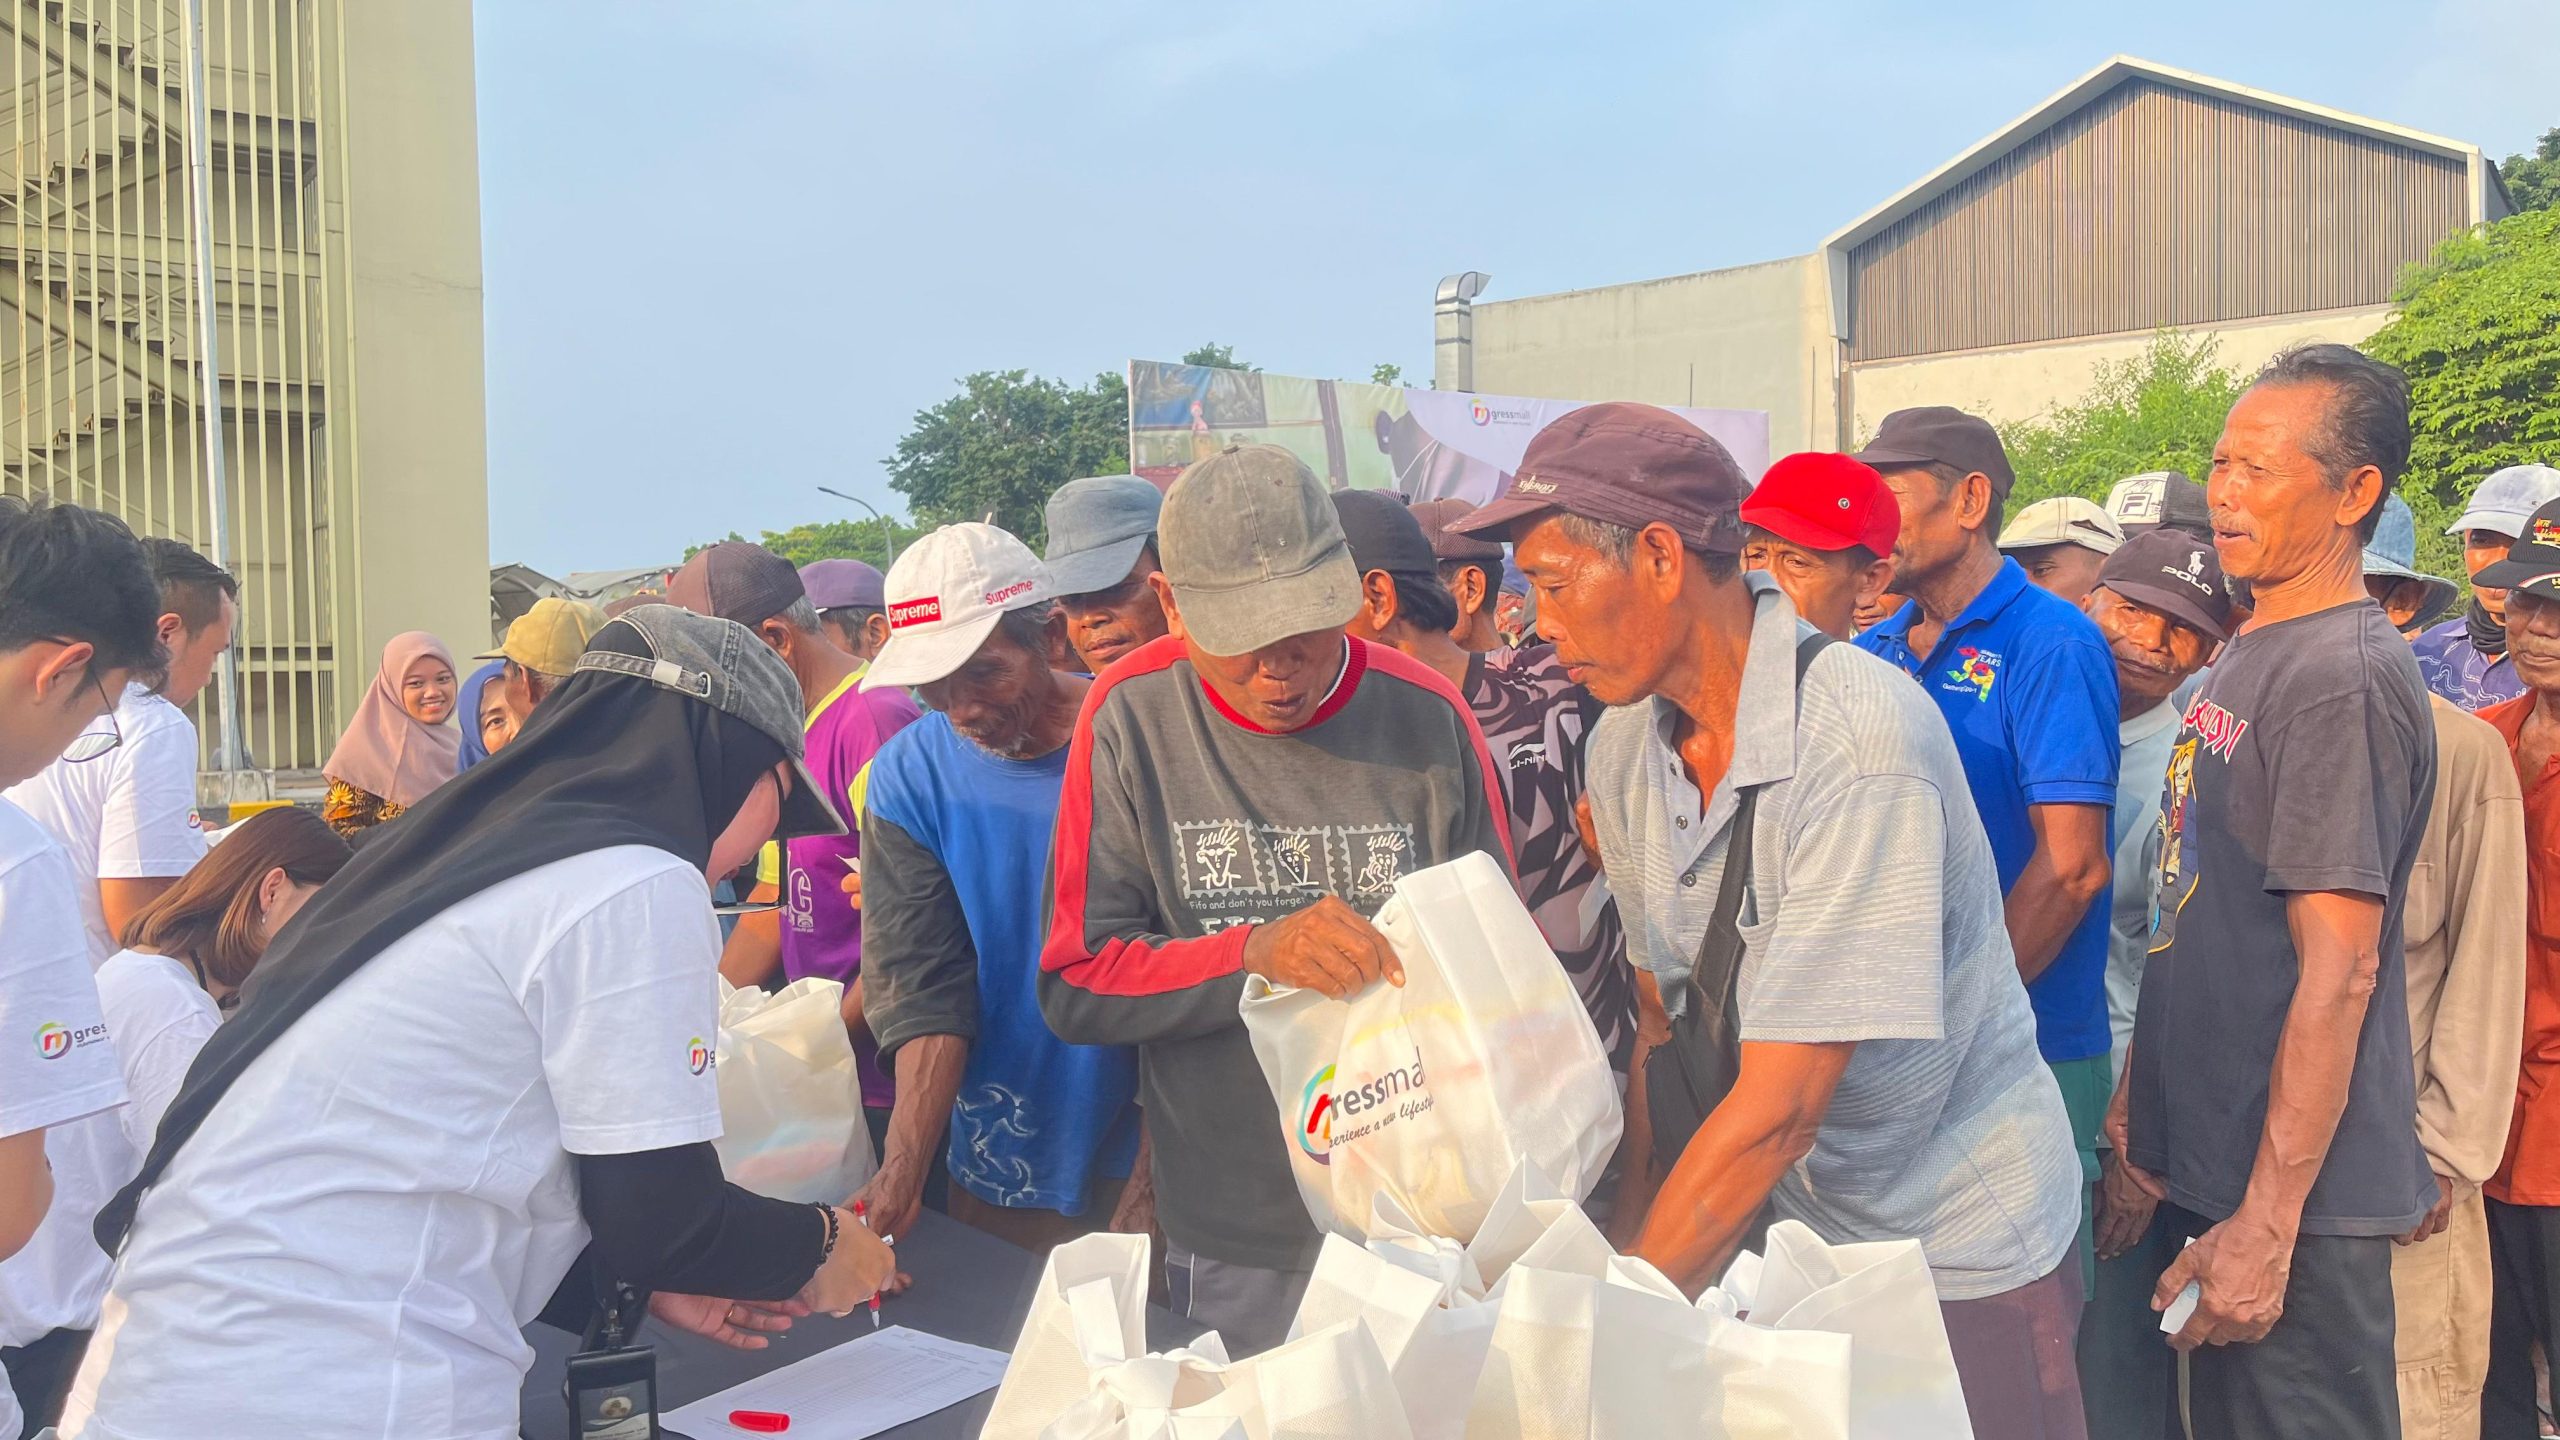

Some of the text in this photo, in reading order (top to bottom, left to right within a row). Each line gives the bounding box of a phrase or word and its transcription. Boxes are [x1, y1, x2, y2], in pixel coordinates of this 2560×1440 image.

[1491, 409, 1532, 421] gressmall
[2161, 565, 2213, 597] POLO
[985, 580, 1033, 605] Supreme
[890, 602, 939, 627] Supreme
[1509, 755, 1546, 770] LI-NIN
[1209, 900, 1226, 910] and
[1228, 898, 1253, 909] don't
[1256, 899, 1273, 909] you
[74, 1024, 108, 1043] gres
